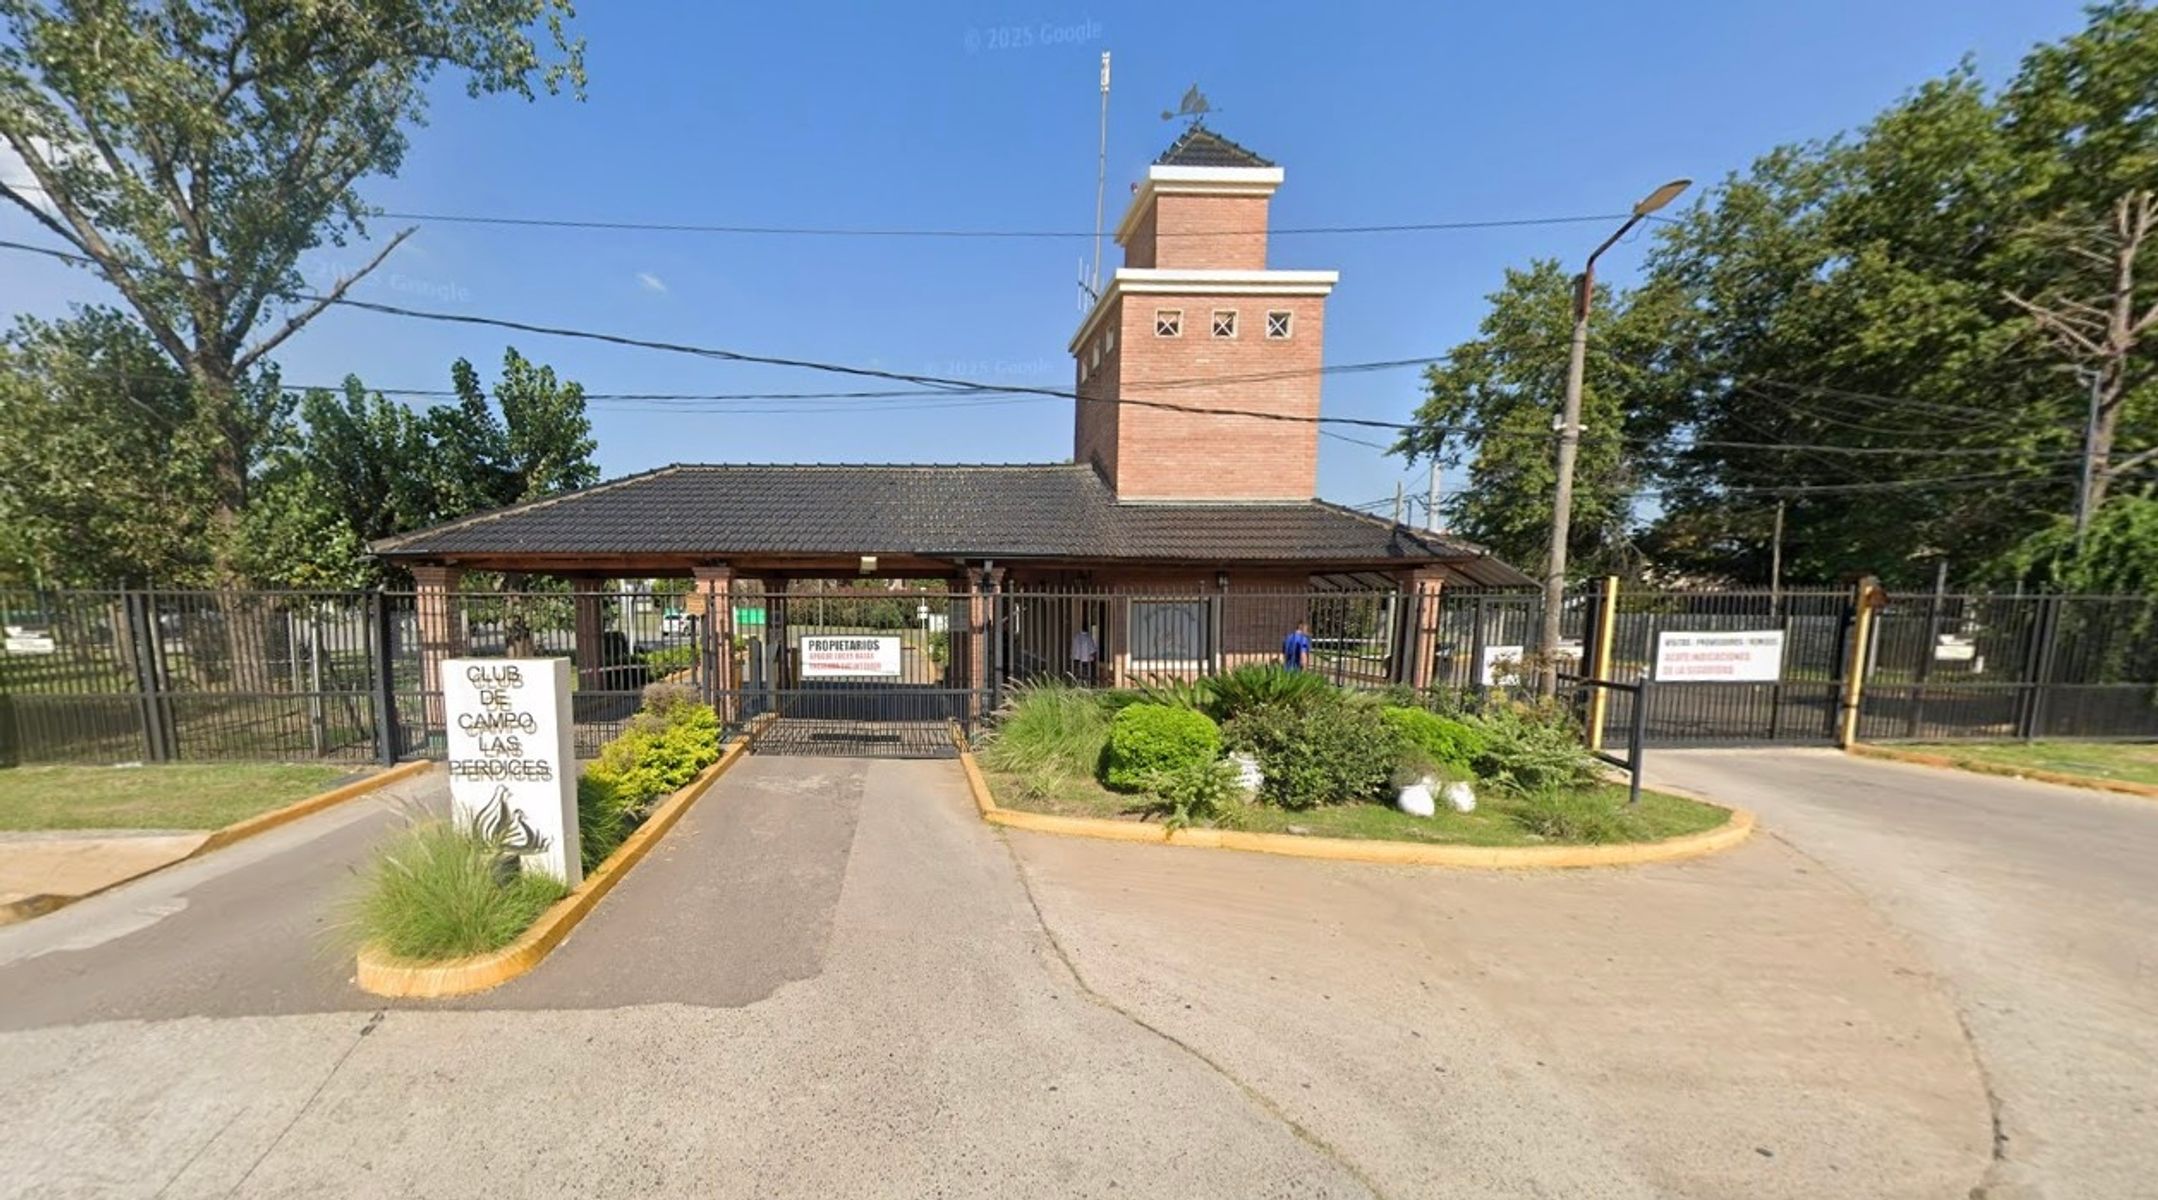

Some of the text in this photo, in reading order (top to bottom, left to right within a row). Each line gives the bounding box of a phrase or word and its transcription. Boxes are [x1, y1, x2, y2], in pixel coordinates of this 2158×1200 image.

[808, 639, 881, 652] PROPIETARIOS
[466, 665, 521, 683] CLUB
[480, 689, 508, 706] DE
[457, 712, 534, 730] CAMPO
[479, 735, 521, 752] LAS
[448, 759, 550, 777] PERDICES
